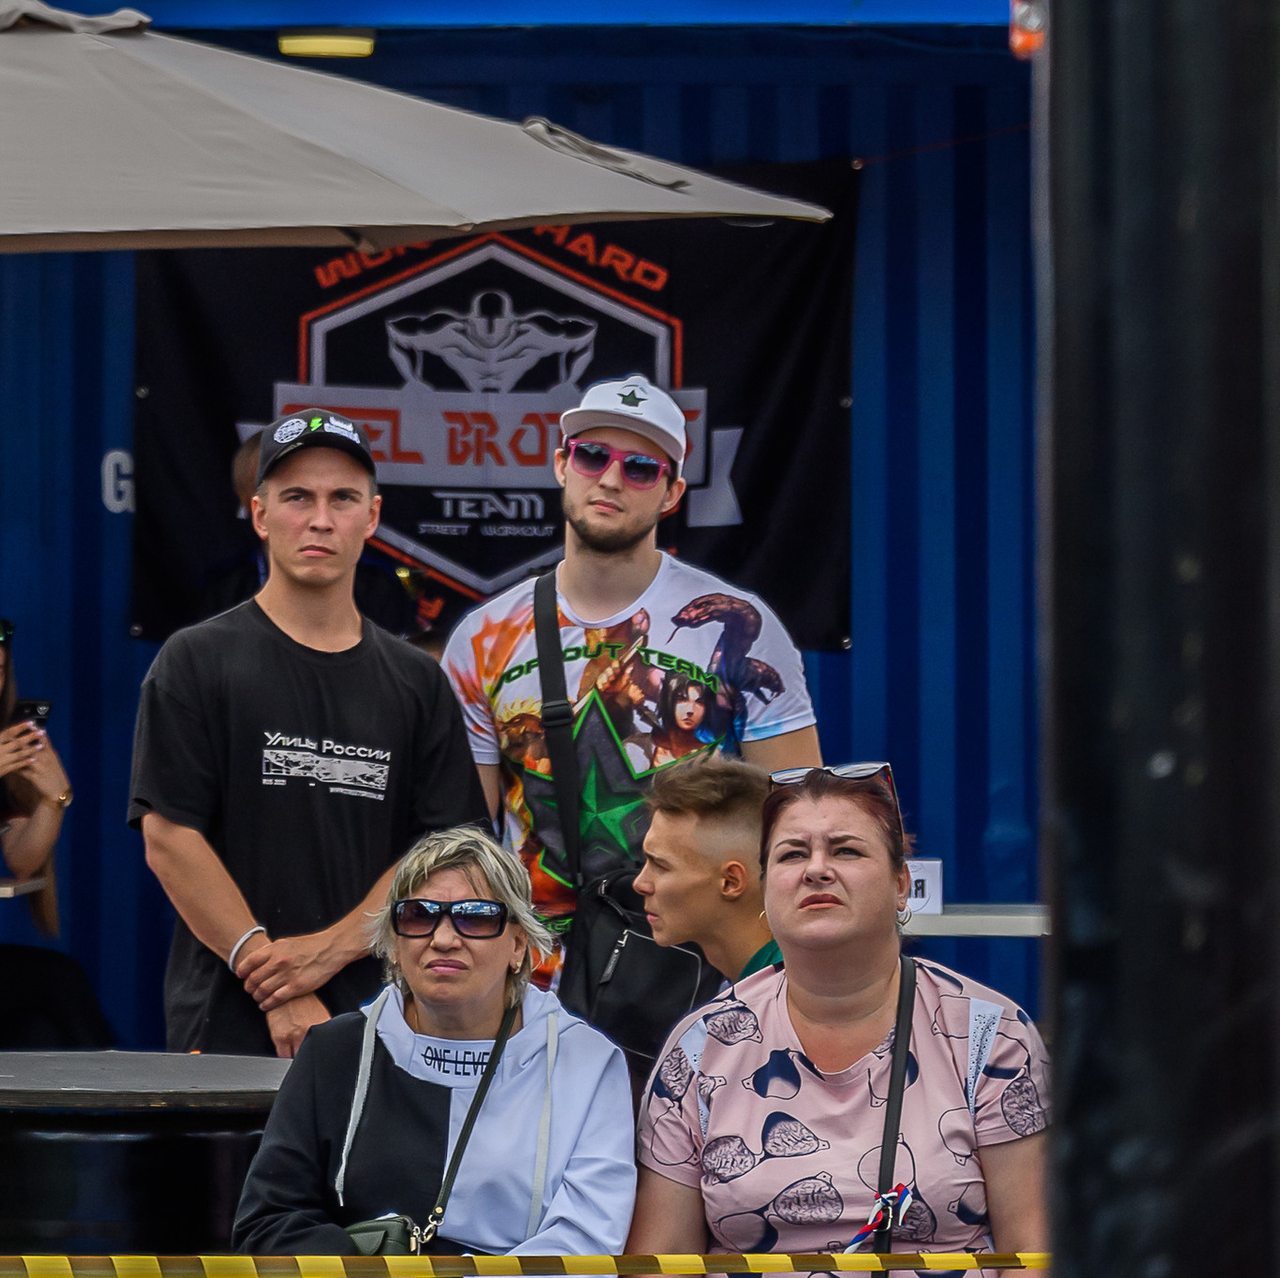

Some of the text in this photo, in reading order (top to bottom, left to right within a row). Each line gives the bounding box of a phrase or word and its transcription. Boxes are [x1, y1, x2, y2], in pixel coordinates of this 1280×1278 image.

[432, 492, 545, 519] TEAM
[636, 644, 720, 694] TEAM
[322, 739, 392, 762] России
[423, 1045, 492, 1076] ONE LEVE
